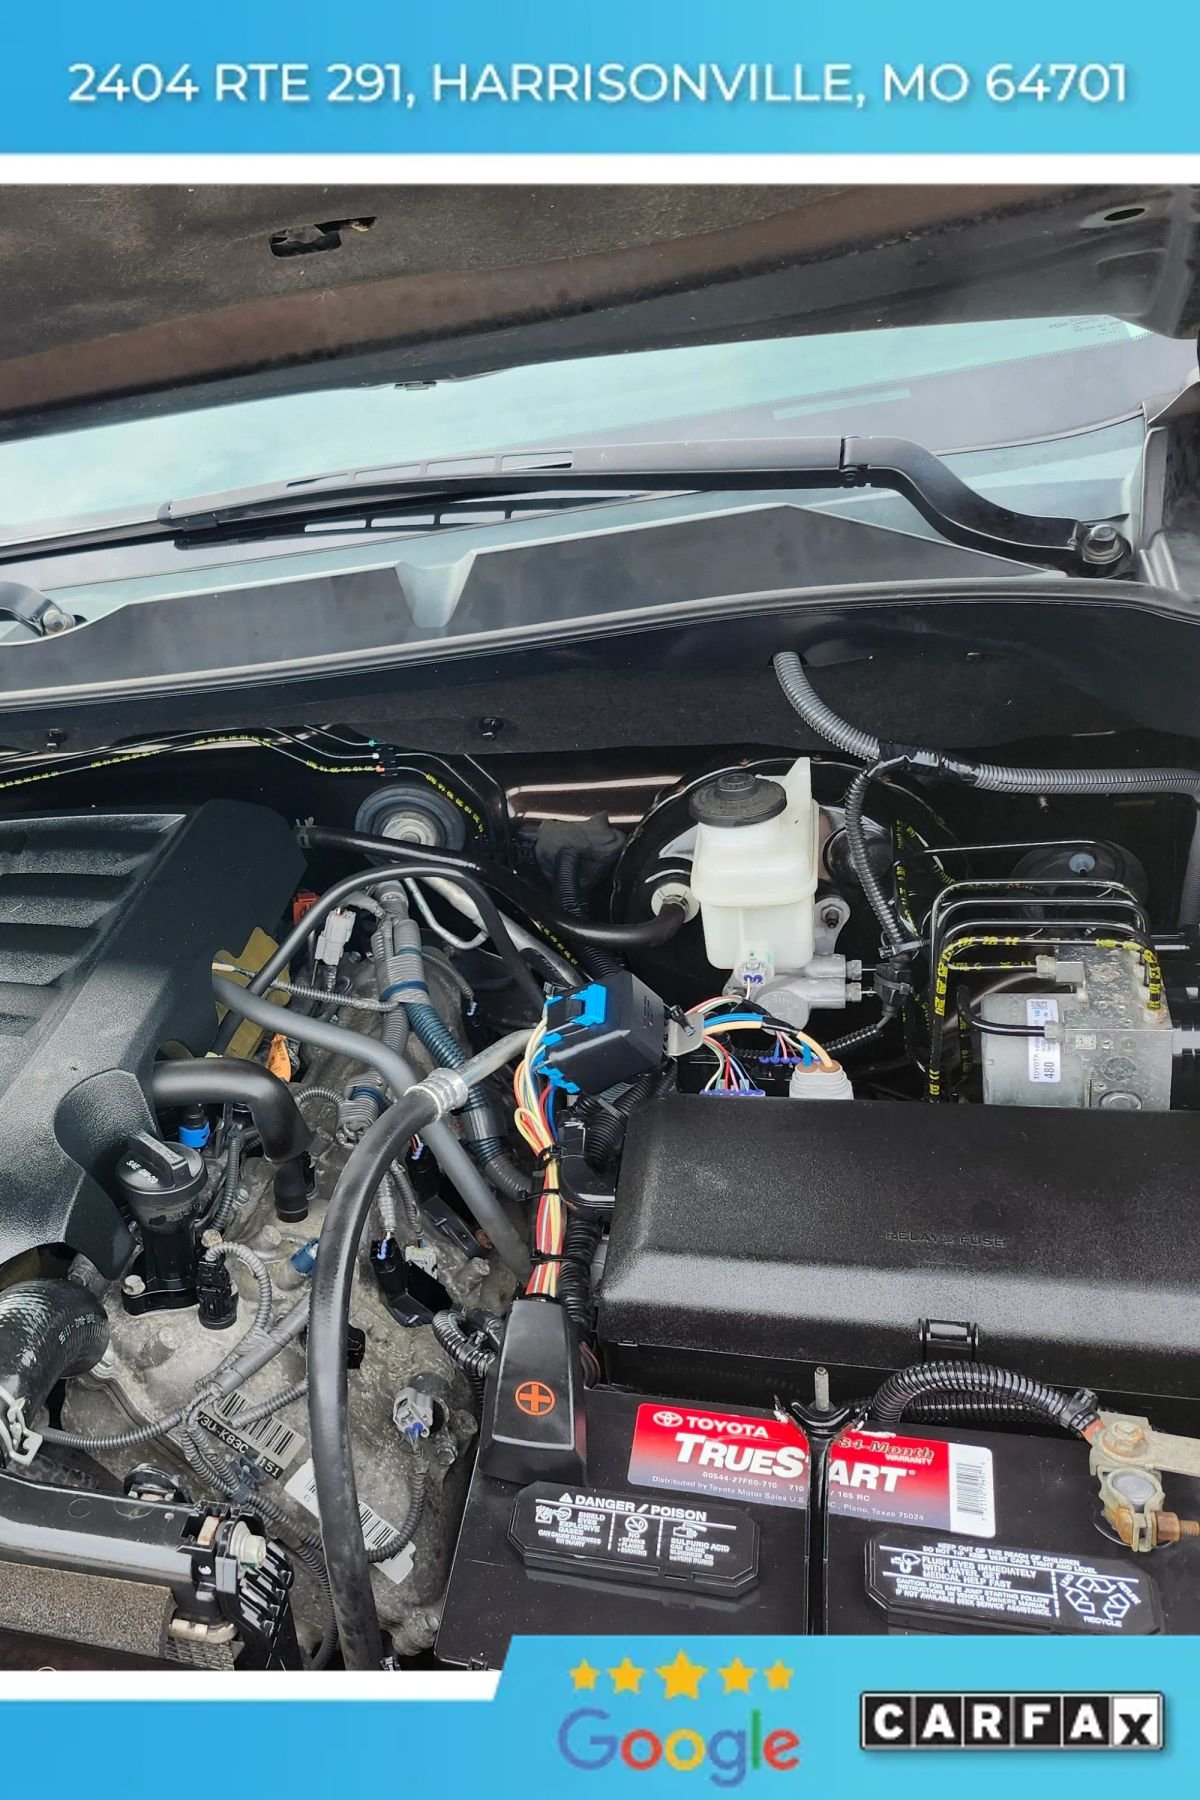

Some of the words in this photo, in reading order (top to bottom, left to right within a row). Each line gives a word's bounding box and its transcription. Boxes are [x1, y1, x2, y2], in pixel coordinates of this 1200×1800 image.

[686, 1415, 769, 1438] TOYOTA
[259, 1458, 281, 1477] 151
[885, 1453, 934, 1466] WARRANTY
[652, 1475, 696, 1488] Distributed
[697, 1482, 708, 1490] by
[709, 1484, 736, 1495] Toyota
[737, 1486, 763, 1499] Motor
[764, 1491, 788, 1502] Sales
[872, 1507, 897, 1518] Texas
[898, 1511, 925, 1522] 75024
[788, 1484, 805, 1493] 710
[856, 1494, 871, 1503] RC
[575, 1494, 636, 1513] DANGER
[650, 1504, 708, 1522] POISON
[577, 1511, 606, 1521] SHIELD
[558, 1520, 601, 1533] EXPLOSIVE
[558, 1526, 585, 1536] GASES
[577, 1517, 598, 1526] EYES
[670, 1537, 709, 1550] SULFURIC
[710, 1543, 730, 1553] ACID
[937, 1542, 957, 1550] KEEP
[987, 1548, 1003, 1556] THE
[1003, 1551, 1029, 1560] REACH
[1042, 1556, 1081, 1566] CHILDREN
[922, 1545, 934, 1553] DO
[935, 1547, 951, 1555] NOT
[989, 1554, 1008, 1562] VENT
[1010, 1556, 1031, 1566] CAPS
[1032, 1560, 1055, 1569] TIGHT
[1074, 1565, 1098, 1575] LEVEL
[922, 1555, 951, 1567] FLUSH
[952, 1559, 976, 1570] EYES
[977, 1563, 1037, 1579] IMMEDIATELY
[922, 1562, 945, 1573] WITH
[982, 1571, 1001, 1580] GET
[923, 1570, 961, 1583] MEDICAL
[963, 1575, 987, 1585] HELP
[989, 1580, 1012, 1589] FAST
[897, 1583, 946, 1596] INSTRUCTIONS
[928, 1581, 943, 1589] FOR
[944, 1584, 963, 1592] SAFE
[963, 1587, 983, 1595] JUMP
[984, 1589, 1019, 1600] STARTING
[1020, 1594, 1050, 1606] FOLLOW
[903, 1589, 919, 1598] NOT
[975, 1599, 1005, 1610] SERVICE
[1082, 1615, 1123, 1628] RECYCLE
